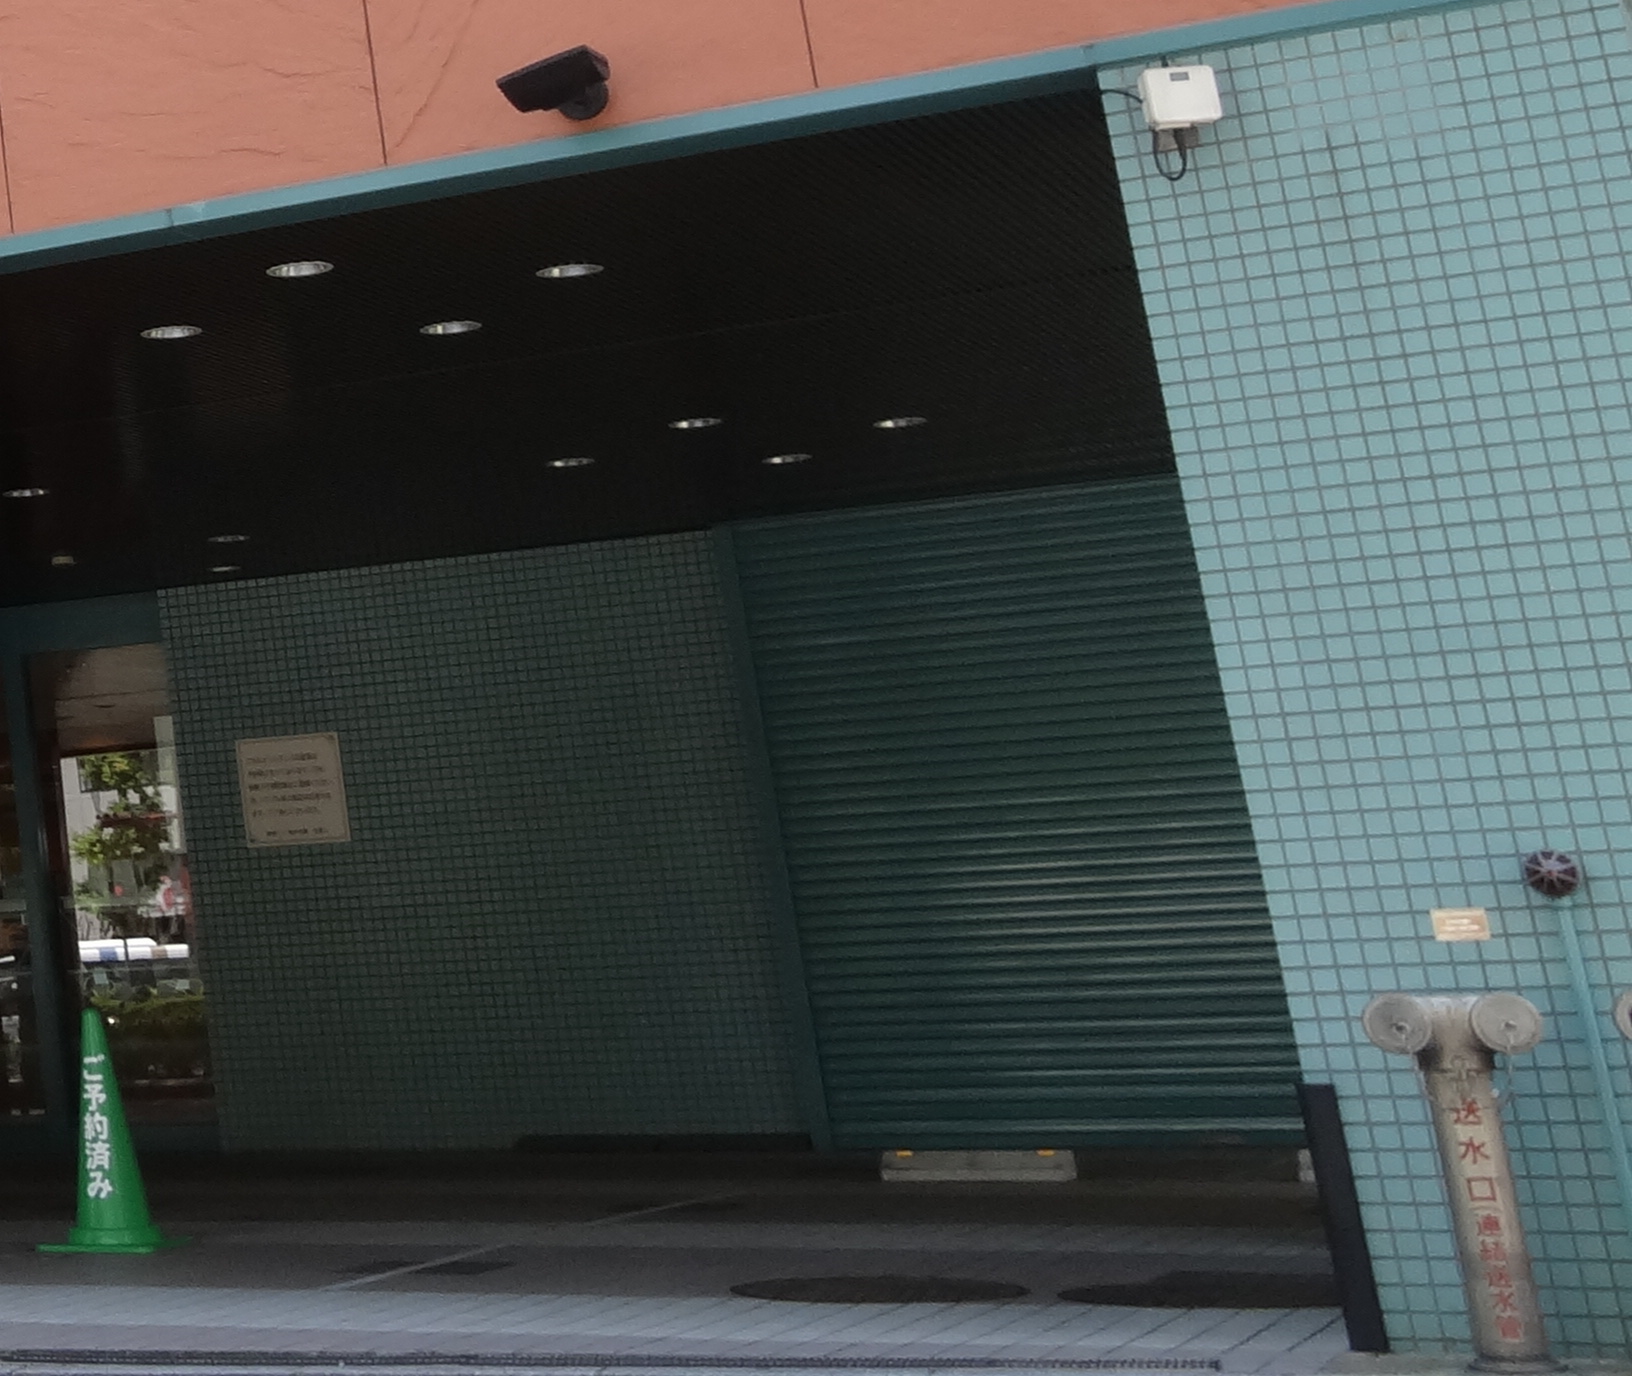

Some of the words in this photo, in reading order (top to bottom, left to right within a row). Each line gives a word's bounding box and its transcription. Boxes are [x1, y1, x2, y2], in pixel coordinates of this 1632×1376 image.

[82, 1053, 114, 1200] ご予約済み
[1452, 1097, 1497, 1202] 送水口
